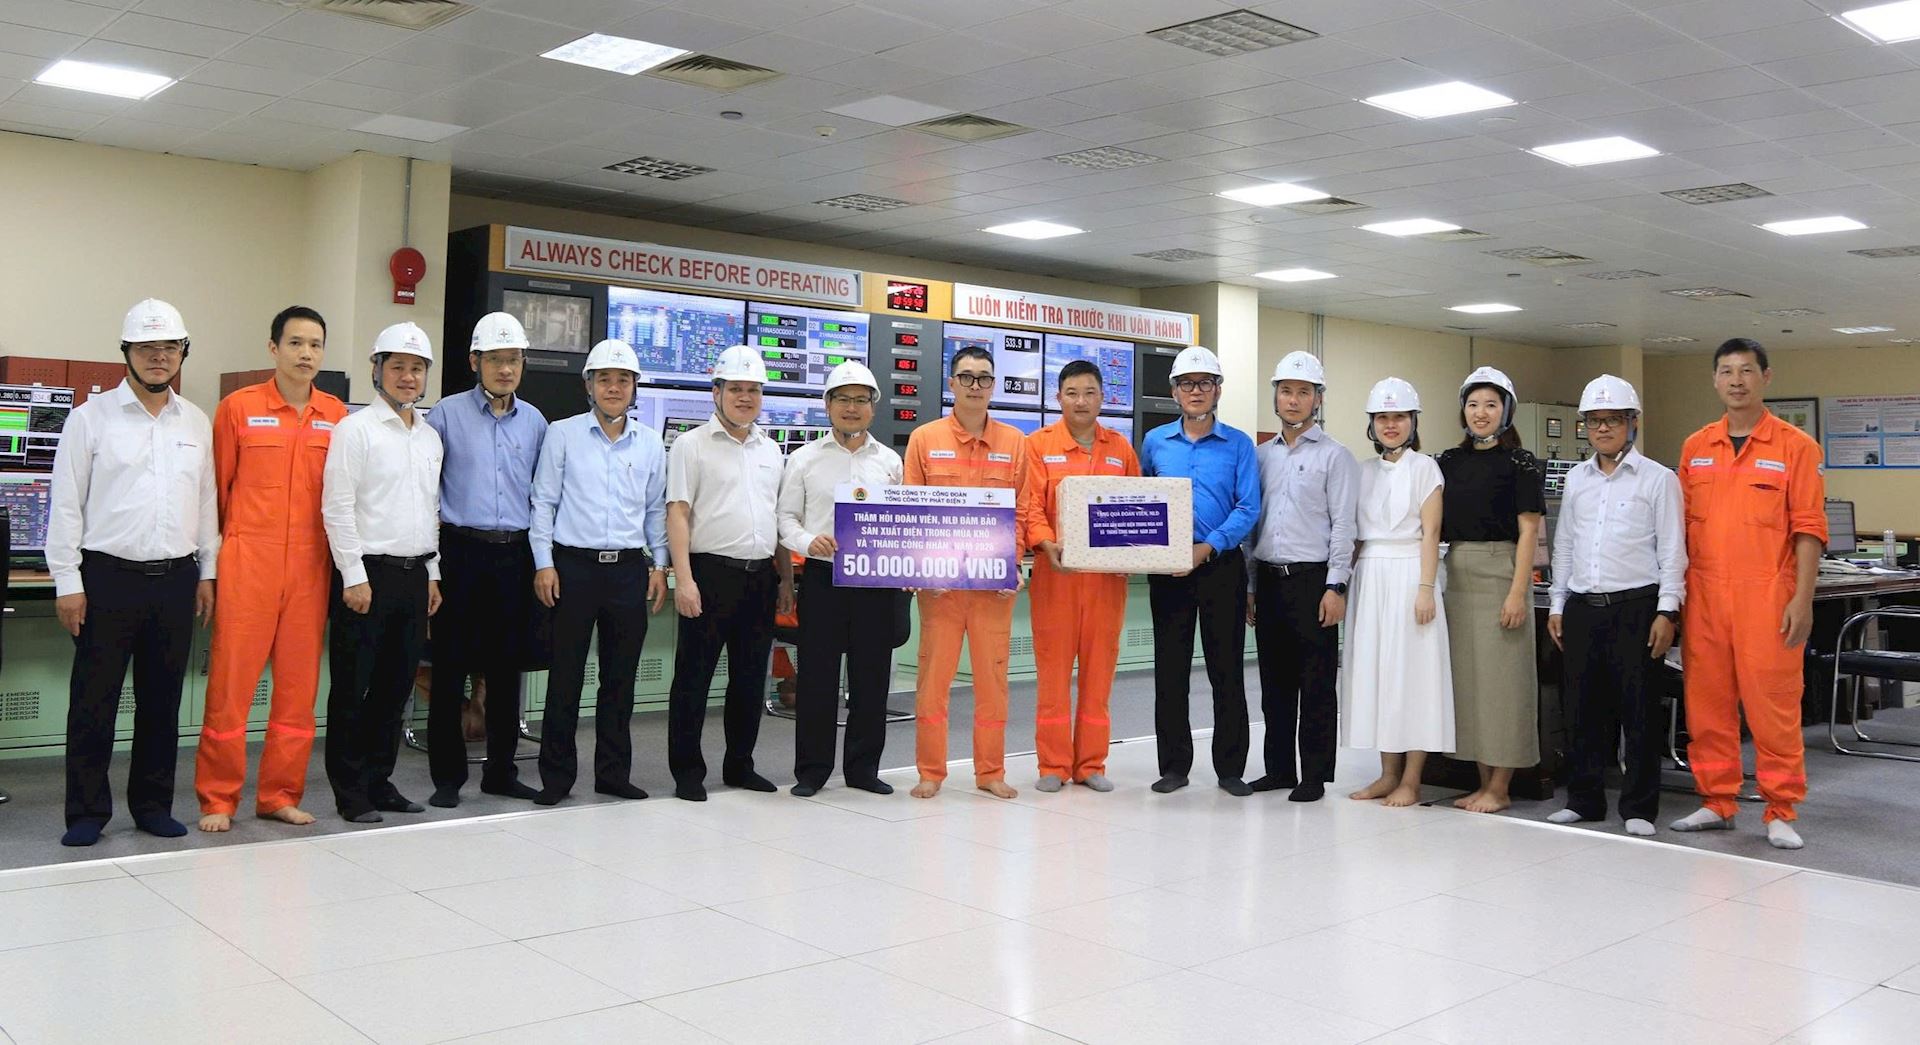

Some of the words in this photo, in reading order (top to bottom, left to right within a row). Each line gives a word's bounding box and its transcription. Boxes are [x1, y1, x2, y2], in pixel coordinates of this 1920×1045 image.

[521, 240, 602, 267] ALWAYS
[608, 250, 674, 276] CHECK
[679, 258, 750, 285] BEFORE
[756, 268, 849, 296] OPERATING
[968, 295, 1001, 317] LUÔN
[1006, 295, 1037, 321] KIỂM
[1041, 305, 1064, 325] TRA
[1067, 308, 1104, 329] TRƯỚC
[1107, 313, 1126, 332] KHI
[1154, 318, 1182, 339] HÀNH
[879, 510, 893, 523] HỎI
[861, 523, 878, 535] SẢN
[880, 524, 901, 536] XUẤT
[924, 528, 951, 538] TRONG
[856, 537, 867, 548] VÀ
[901, 539, 924, 549] CÔNG
[843, 553, 959, 578] 50.000.000
[965, 556, 1008, 580] VNĐ
